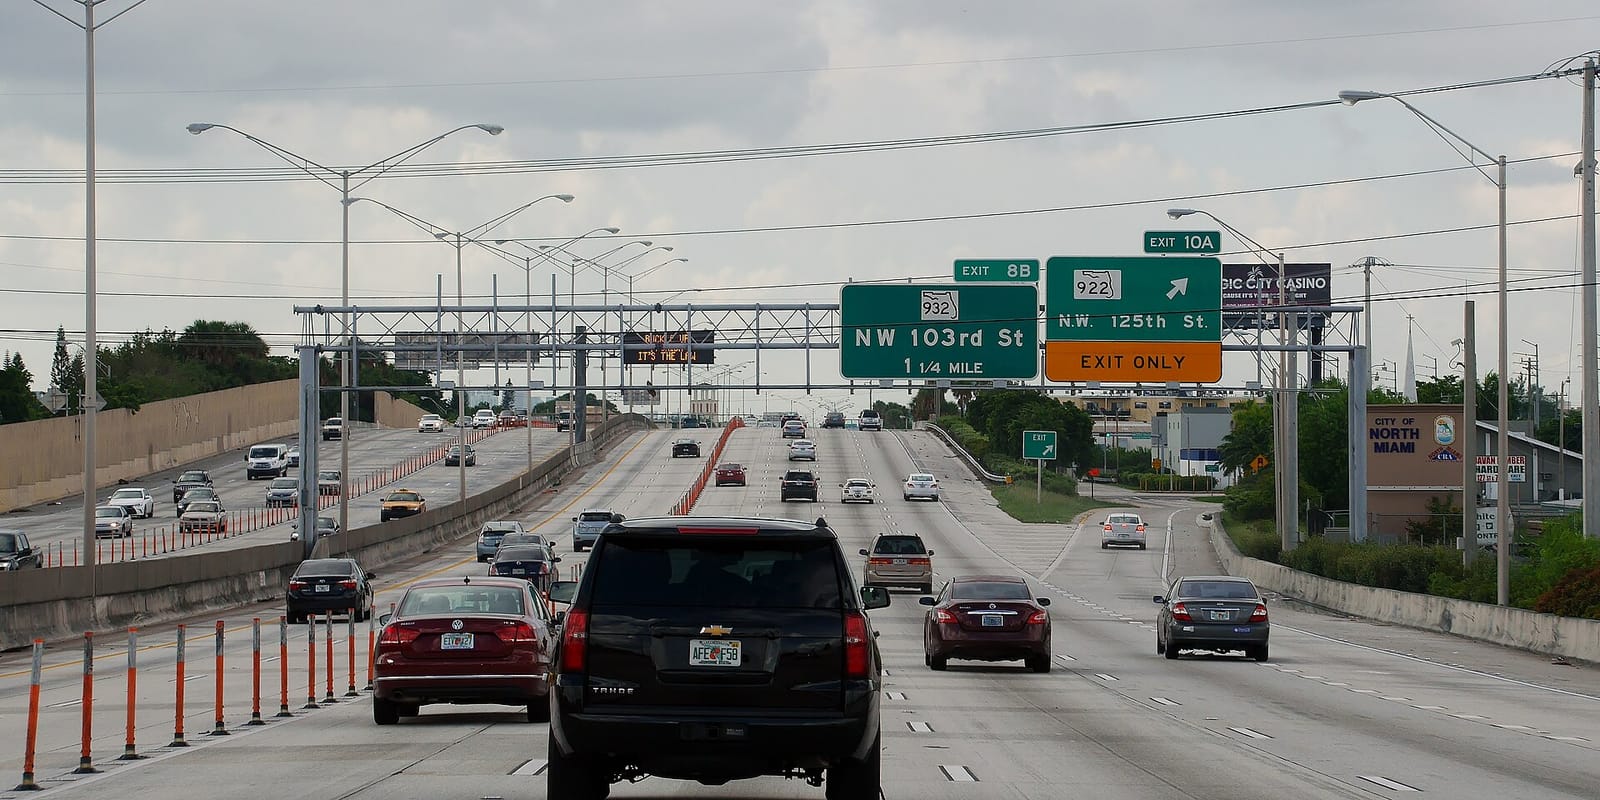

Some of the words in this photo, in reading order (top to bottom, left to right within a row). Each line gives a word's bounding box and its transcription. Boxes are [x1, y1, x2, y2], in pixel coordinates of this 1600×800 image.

[1150, 237, 1176, 248] EXIT
[1184, 235, 1214, 249] 10A
[962, 266, 990, 276] EXIT
[1007, 264, 1031, 278] 8B
[1077, 281, 1109, 295] 922
[1276, 277, 1326, 289] CASINO
[923, 302, 949, 315] 932
[1059, 314, 1093, 328] N.W.
[1111, 315, 1166, 328] 125th
[1183, 315, 1208, 328] St.
[645, 334, 674, 343] BUCKE
[855, 328, 896, 347] NW
[911, 328, 983, 347] 103rd
[998, 328, 1024, 347] St
[638, 351, 656, 361] IT'S
[660, 351, 676, 361] THE
[1081, 355, 1124, 369] EXIT
[1133, 355, 1185, 369] ONLY
[904, 357, 911, 374] 1
[919, 360, 941, 374] 1/4
[949, 362, 983, 374] MILE
[1375, 417, 1396, 426] CITY
[1402, 417, 1415, 425] OF
[1032, 433, 1046, 441] EXIT
[1369, 428, 1420, 440] NORTH
[1374, 441, 1415, 453] MIAMI
[1476, 456, 1495, 464] AVAN
[1476, 465, 1525, 474] HARDARE
[692, 647, 710, 660] AFE
